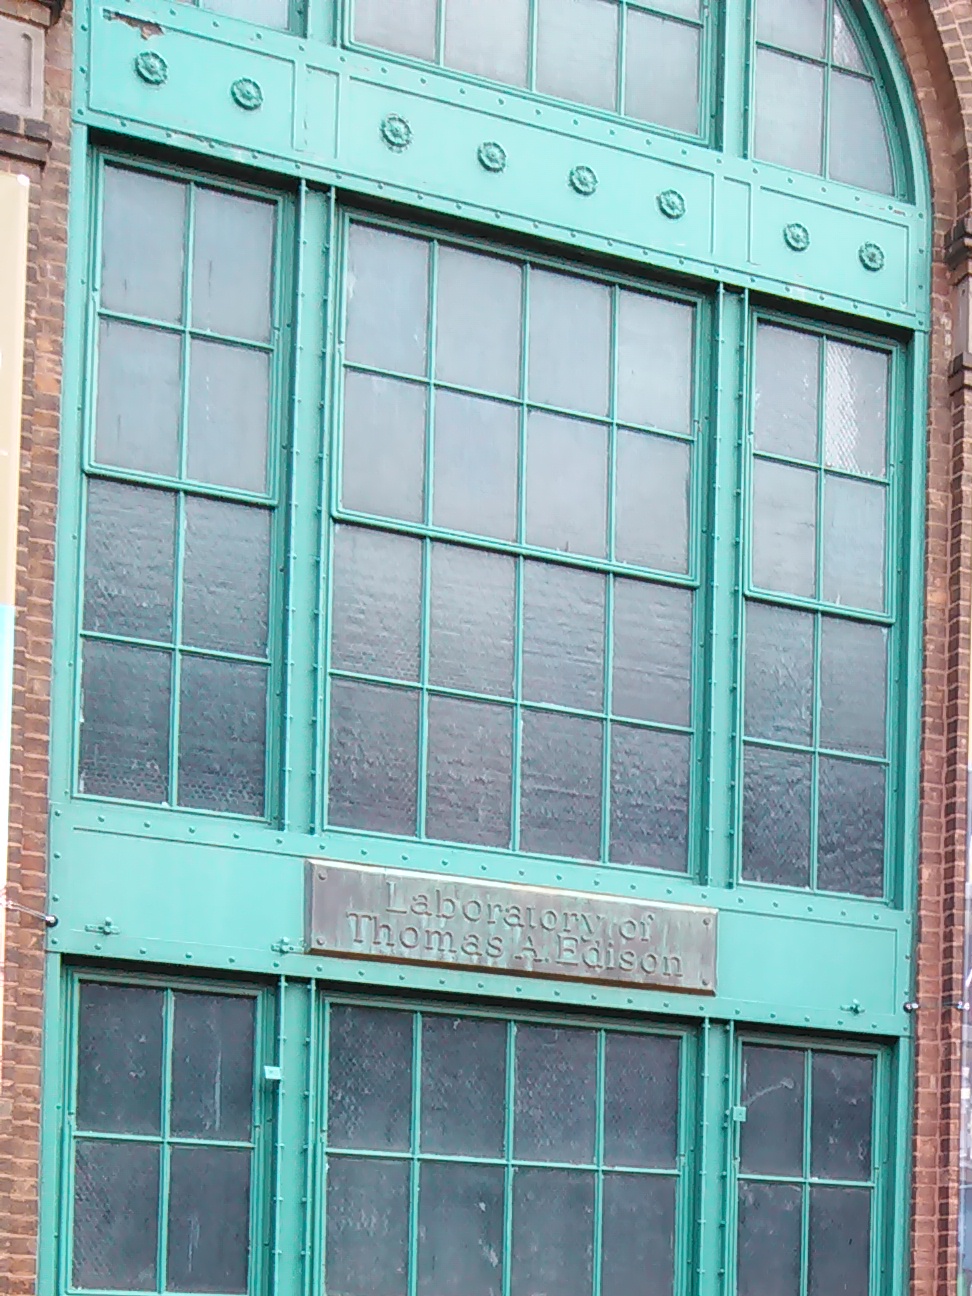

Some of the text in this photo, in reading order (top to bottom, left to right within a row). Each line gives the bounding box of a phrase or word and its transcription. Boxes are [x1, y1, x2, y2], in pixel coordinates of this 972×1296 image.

[345, 910, 504, 959] Thomas
[555, 932, 684, 977] Edison
[385, 880, 656, 943] Laboratory of
